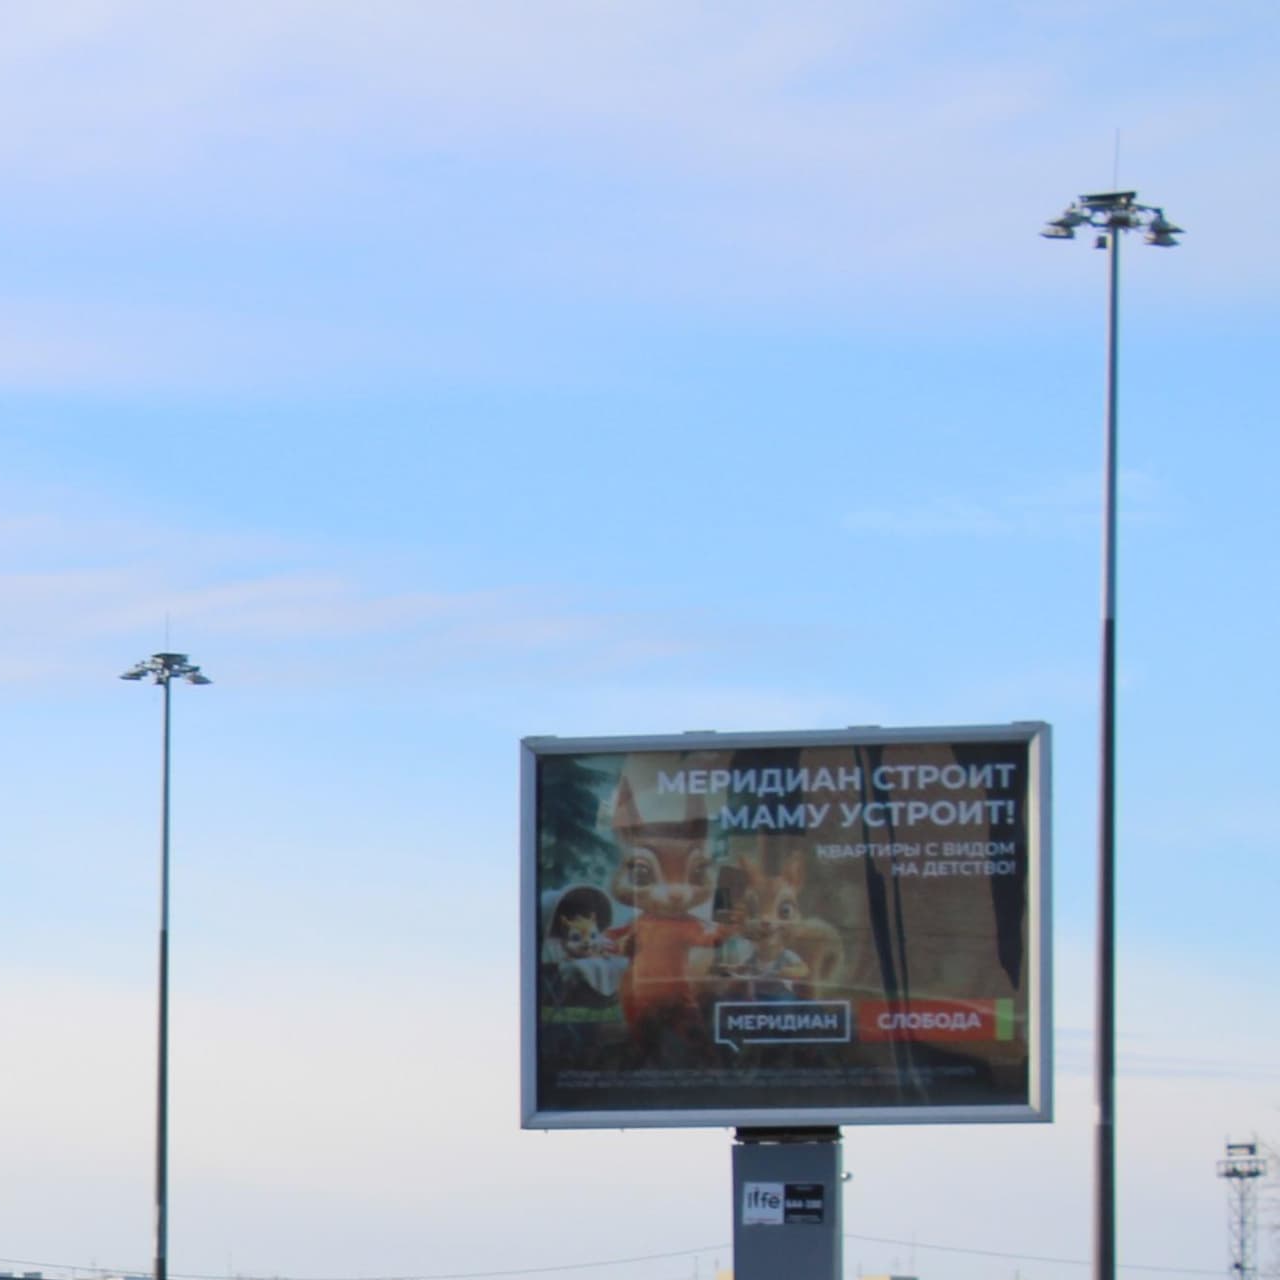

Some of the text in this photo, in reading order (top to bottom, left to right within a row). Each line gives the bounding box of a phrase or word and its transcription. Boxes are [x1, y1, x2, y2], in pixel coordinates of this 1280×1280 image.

[657, 763, 1016, 797] МЕРИДИАН СТРОИТ
[841, 799, 1015, 828] УСТРОИТ!
[816, 841, 1016, 859] КВАРТИРЫ С ВИДОМ
[891, 860, 1016, 877] НА ДЕТСТВО!
[726, 1015, 838, 1031] МЕРИДИАН
[877, 1012, 982, 1030] СЛОБОДА
